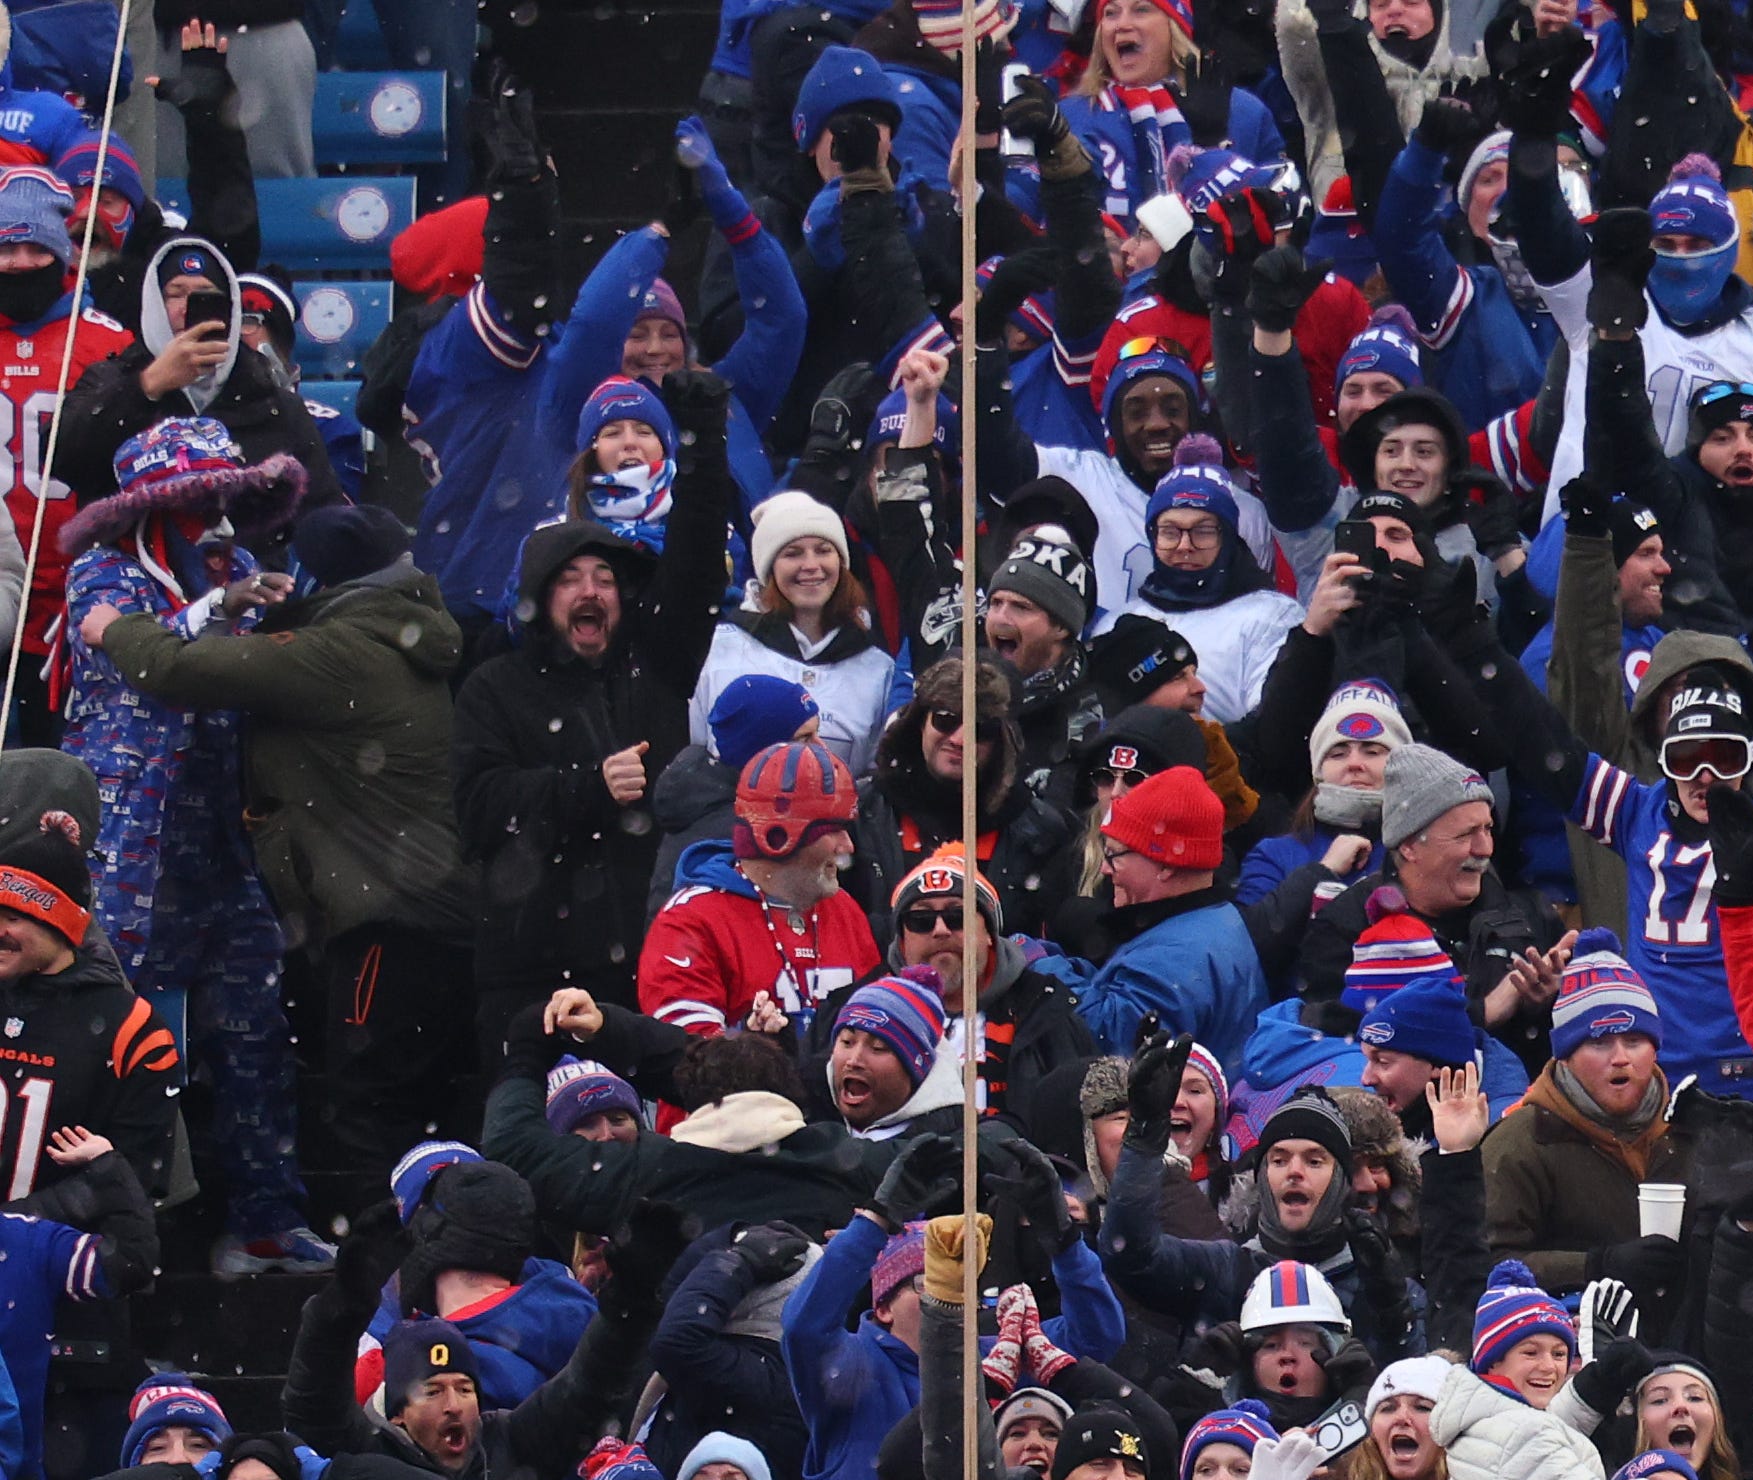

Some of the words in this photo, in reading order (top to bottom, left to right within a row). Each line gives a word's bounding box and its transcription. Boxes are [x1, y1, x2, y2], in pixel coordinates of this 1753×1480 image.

[0, 109, 34, 133] UF
[1670, 688, 1740, 719] BILLS
[1643, 832, 1718, 947] 17
[0, 1047, 55, 1069] GALS
[0, 1078, 53, 1203] 1
[430, 1343, 450, 1367] Q
